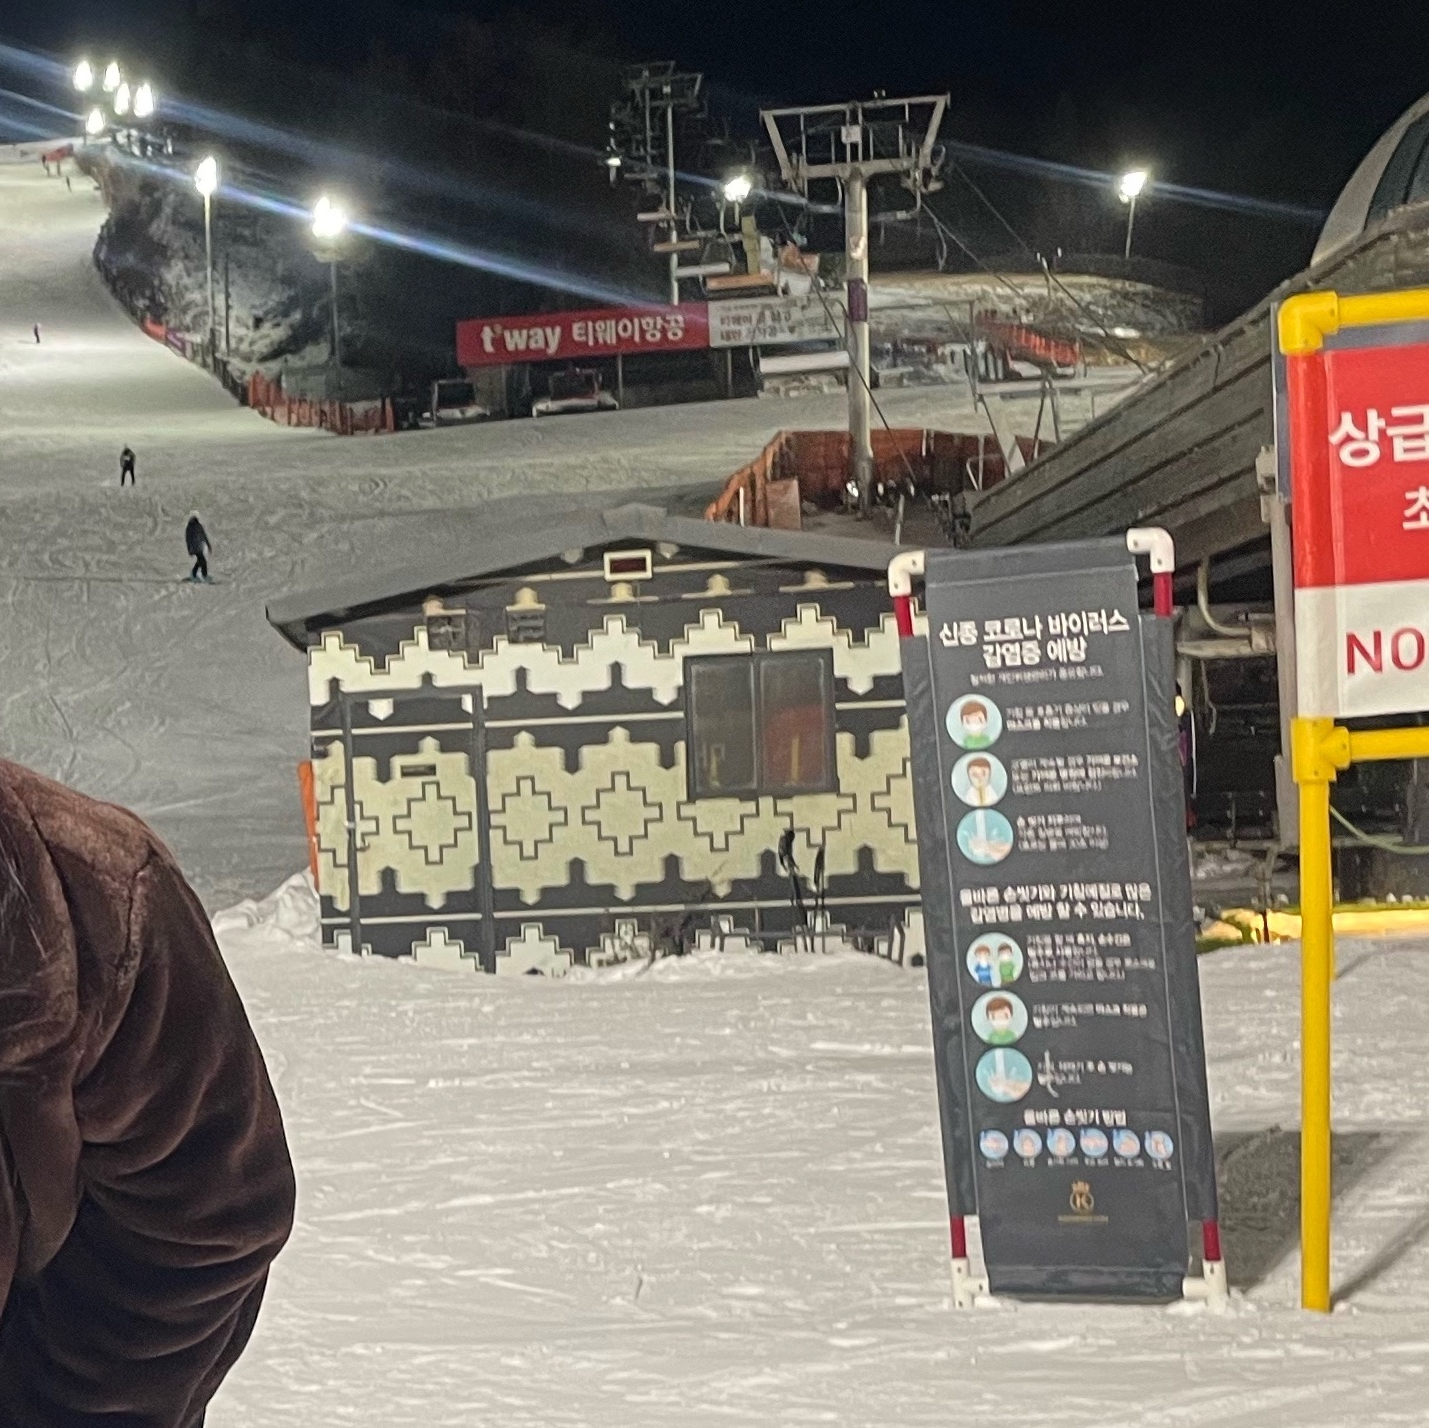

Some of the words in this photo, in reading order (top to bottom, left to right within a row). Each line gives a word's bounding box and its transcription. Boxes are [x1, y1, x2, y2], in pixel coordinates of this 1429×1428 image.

[573, 314, 685, 346] 티웨이항공
[939, 620, 978, 648] 신종
[983, 614, 1043, 642] 코로나
[1047, 608, 1130, 637] 바이러스
[982, 639, 1042, 669] 감염증
[1047, 635, 1088, 664] 예방
